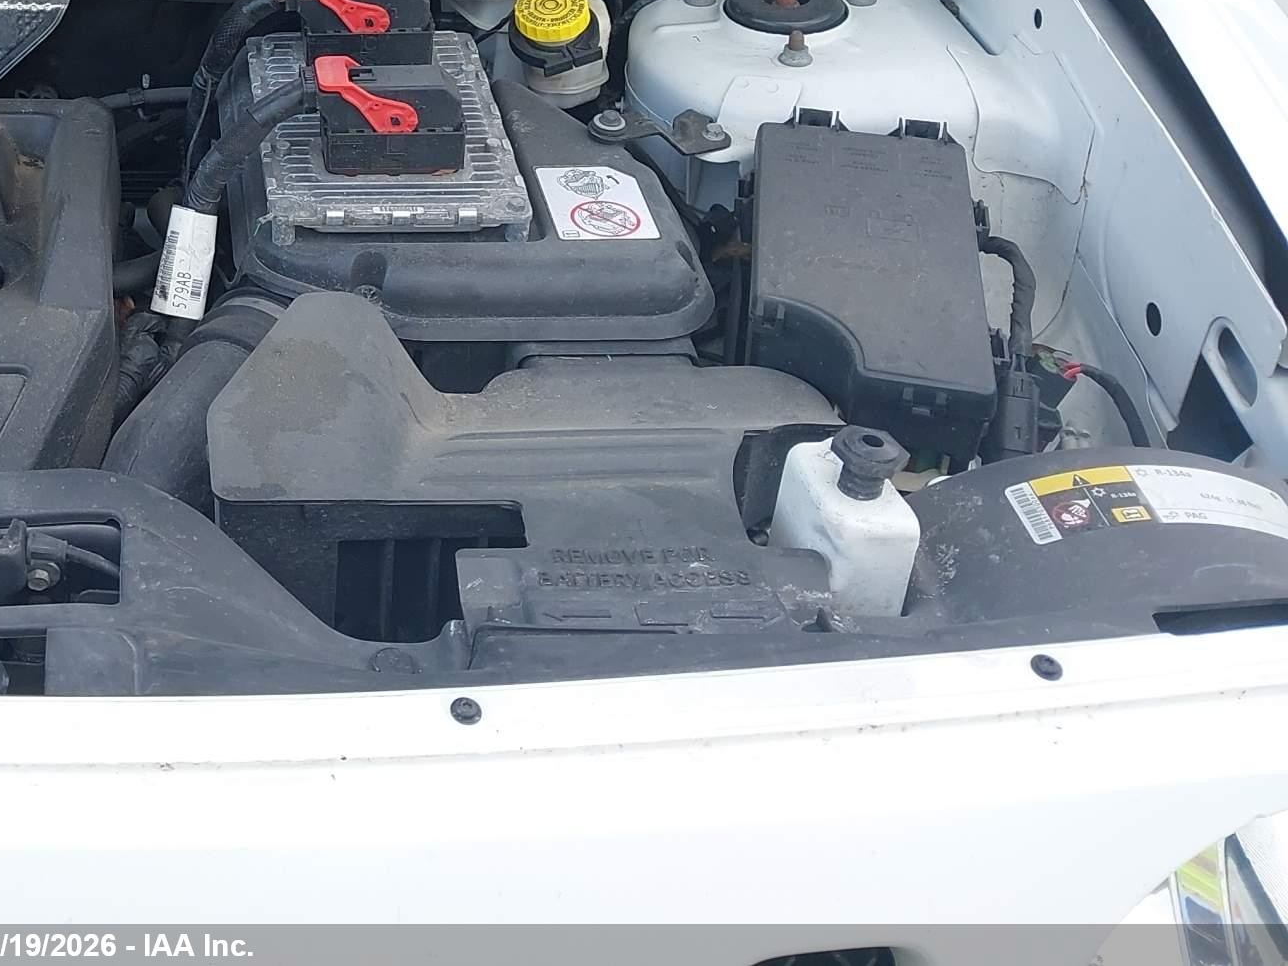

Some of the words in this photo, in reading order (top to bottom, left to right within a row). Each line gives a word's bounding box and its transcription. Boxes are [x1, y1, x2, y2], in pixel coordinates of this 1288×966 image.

[172, 272, 192, 309] 579AB
[1184, 512, 1209, 520] PAG
[551, 547, 656, 564] REMOVE
[662, 546, 716, 563] FOR
[537, 571, 642, 588] BATTERY
[654, 570, 752, 587] ACCESS
